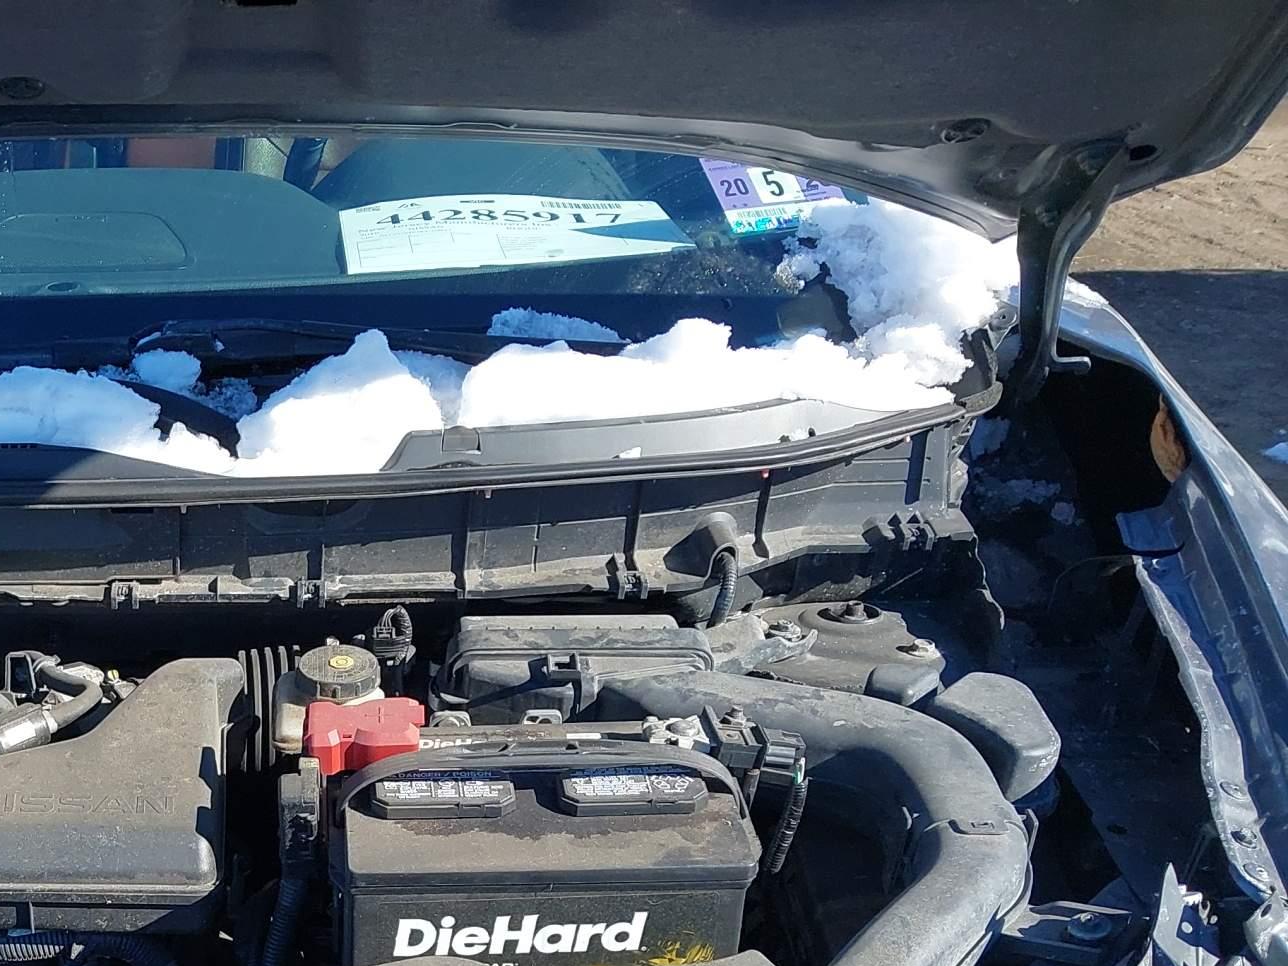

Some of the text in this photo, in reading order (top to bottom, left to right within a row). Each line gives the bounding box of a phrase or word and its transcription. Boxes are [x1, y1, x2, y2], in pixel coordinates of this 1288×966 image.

[719, 178, 749, 197] 20
[762, 170, 785, 197] 5
[376, 208, 621, 225] 44285917
[393, 912, 649, 957] DieHard
